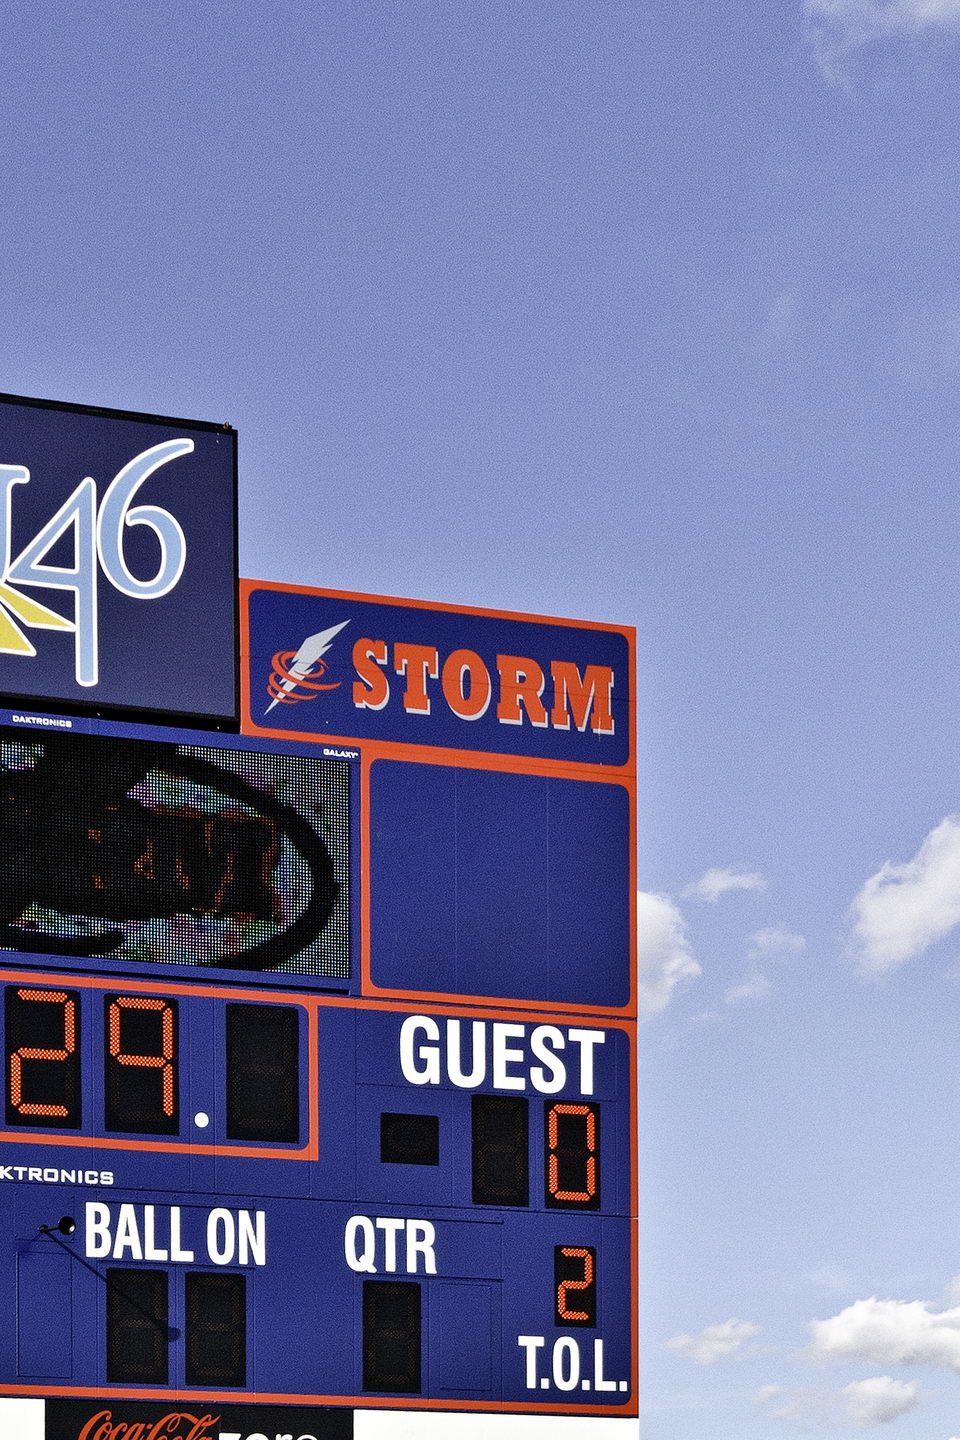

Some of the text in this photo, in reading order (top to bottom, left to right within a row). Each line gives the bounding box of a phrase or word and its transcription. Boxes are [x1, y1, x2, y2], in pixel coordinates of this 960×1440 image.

[351, 637, 615, 736] STORM
[12, 715, 73, 728] DAKTRONICS
[398, 1015, 606, 1096] GUEST
[547, 1103, 597, 1202] 0
[84, 1202, 267, 1266] BALL ON
[343, 1215, 438, 1276] QTR
[556, 1247, 594, 1321] 2
[518, 1335, 629, 1392] T.O.L.
